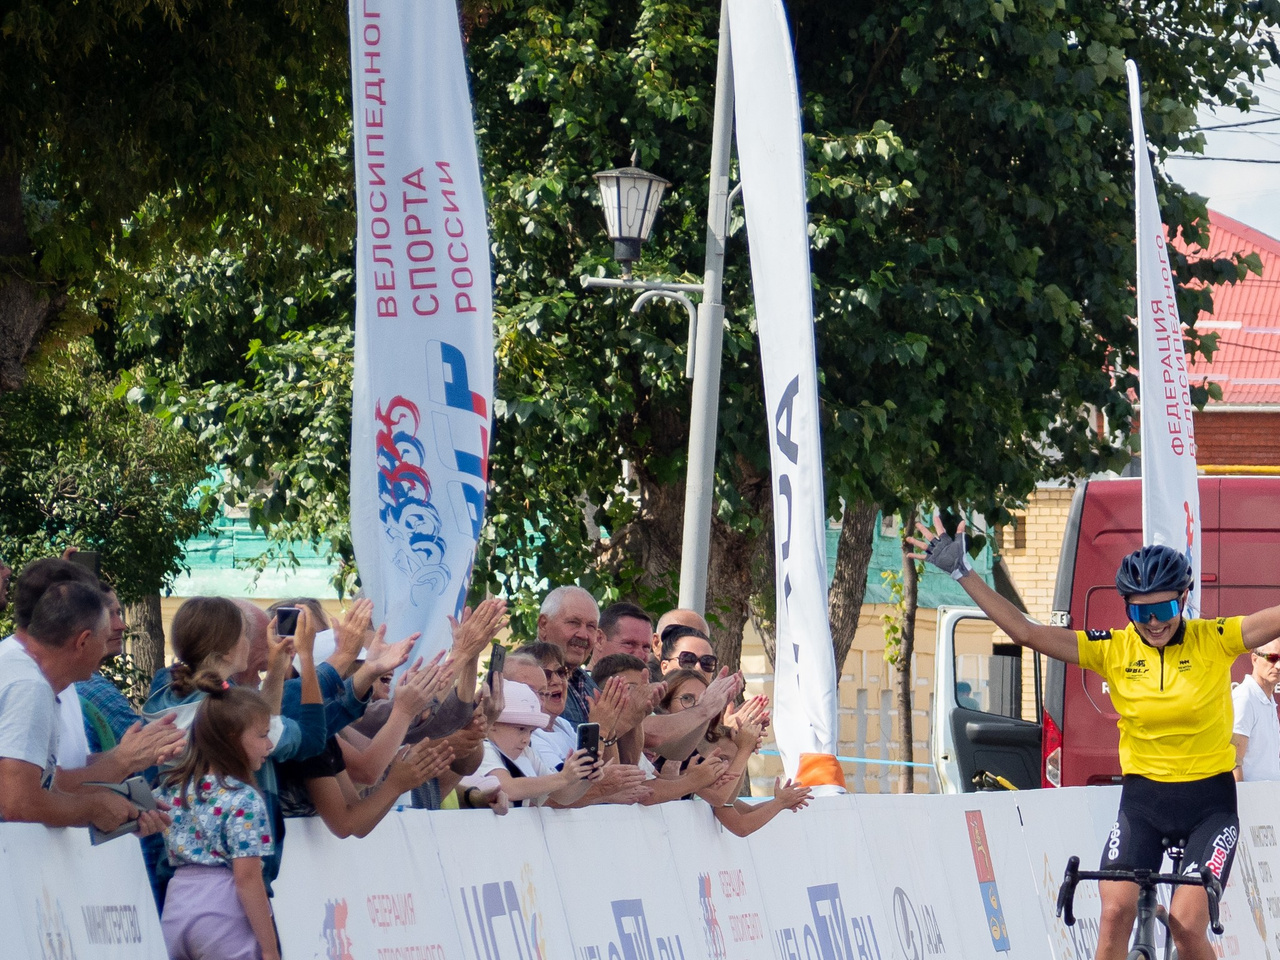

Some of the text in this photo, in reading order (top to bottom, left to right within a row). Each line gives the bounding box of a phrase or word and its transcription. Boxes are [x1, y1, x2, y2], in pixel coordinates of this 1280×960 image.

[402, 167, 440, 316] СПОРТА
[435, 160, 477, 314] РОССИИ
[1151, 300, 1185, 456] ФЕДЕРАЦИЯ
